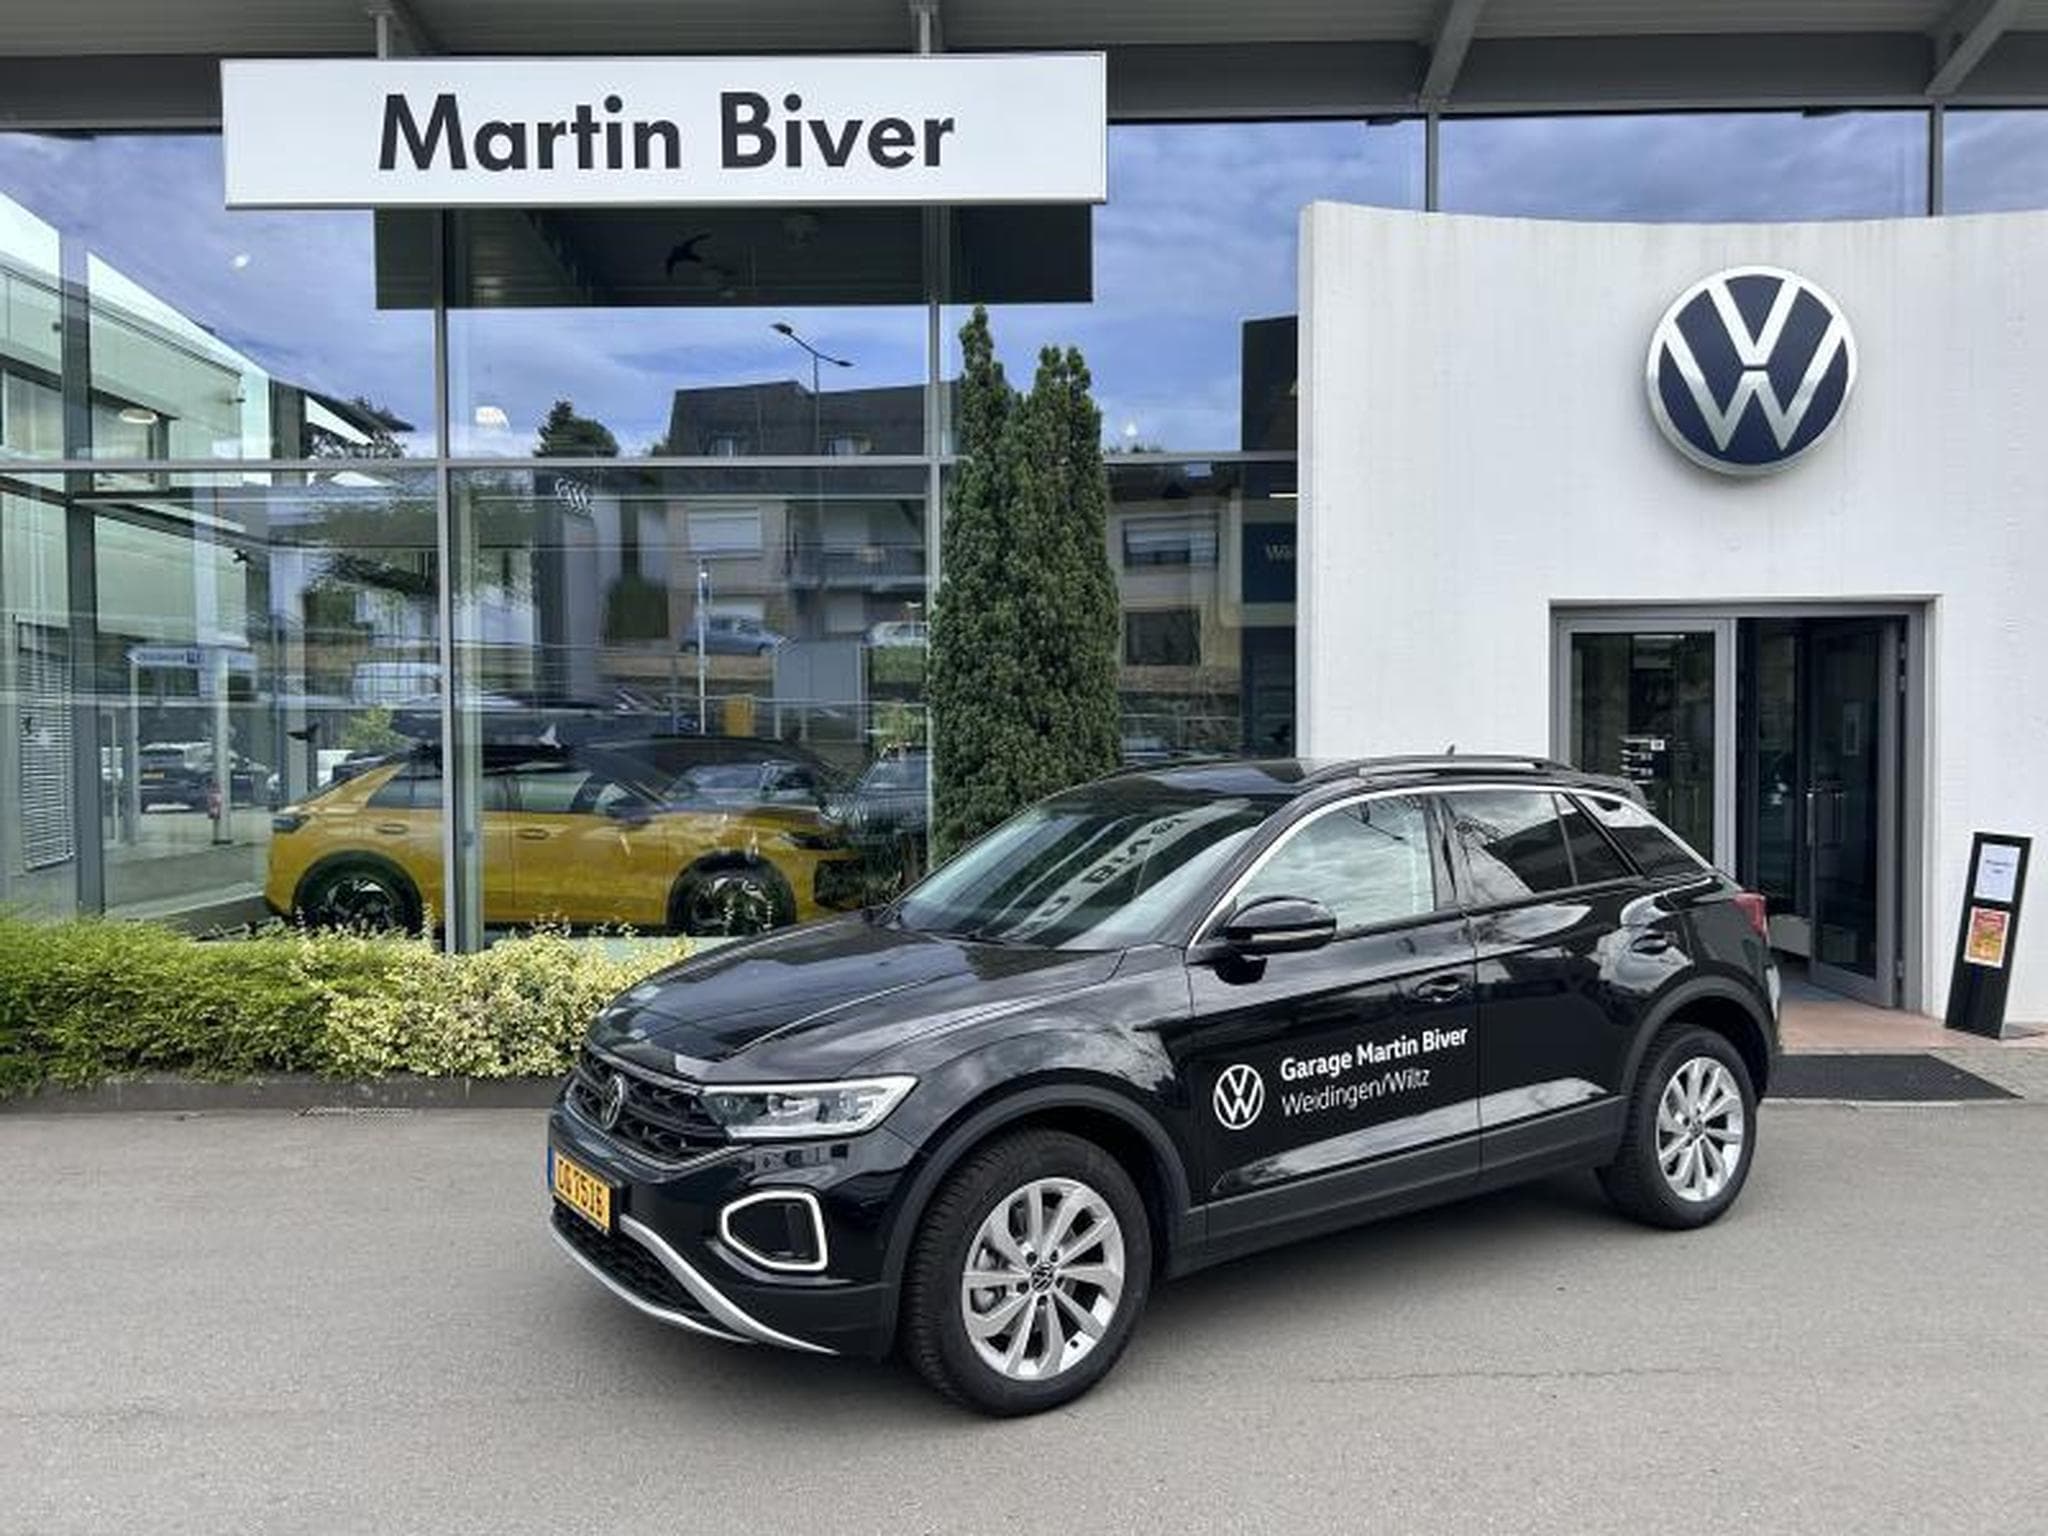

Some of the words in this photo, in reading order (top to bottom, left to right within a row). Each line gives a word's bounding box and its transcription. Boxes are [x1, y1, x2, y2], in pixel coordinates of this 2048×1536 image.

[379, 93, 680, 171] Martin
[720, 91, 954, 169] Biver
[1656, 272, 1850, 456] VW
[1280, 1051, 1353, 1082] Garage
[1356, 1035, 1419, 1066] Martin
[1422, 1028, 1469, 1052] Biver
[1212, 1063, 1266, 1131] VW
[1281, 1069, 1431, 1117] Weidingen/Wiltz
